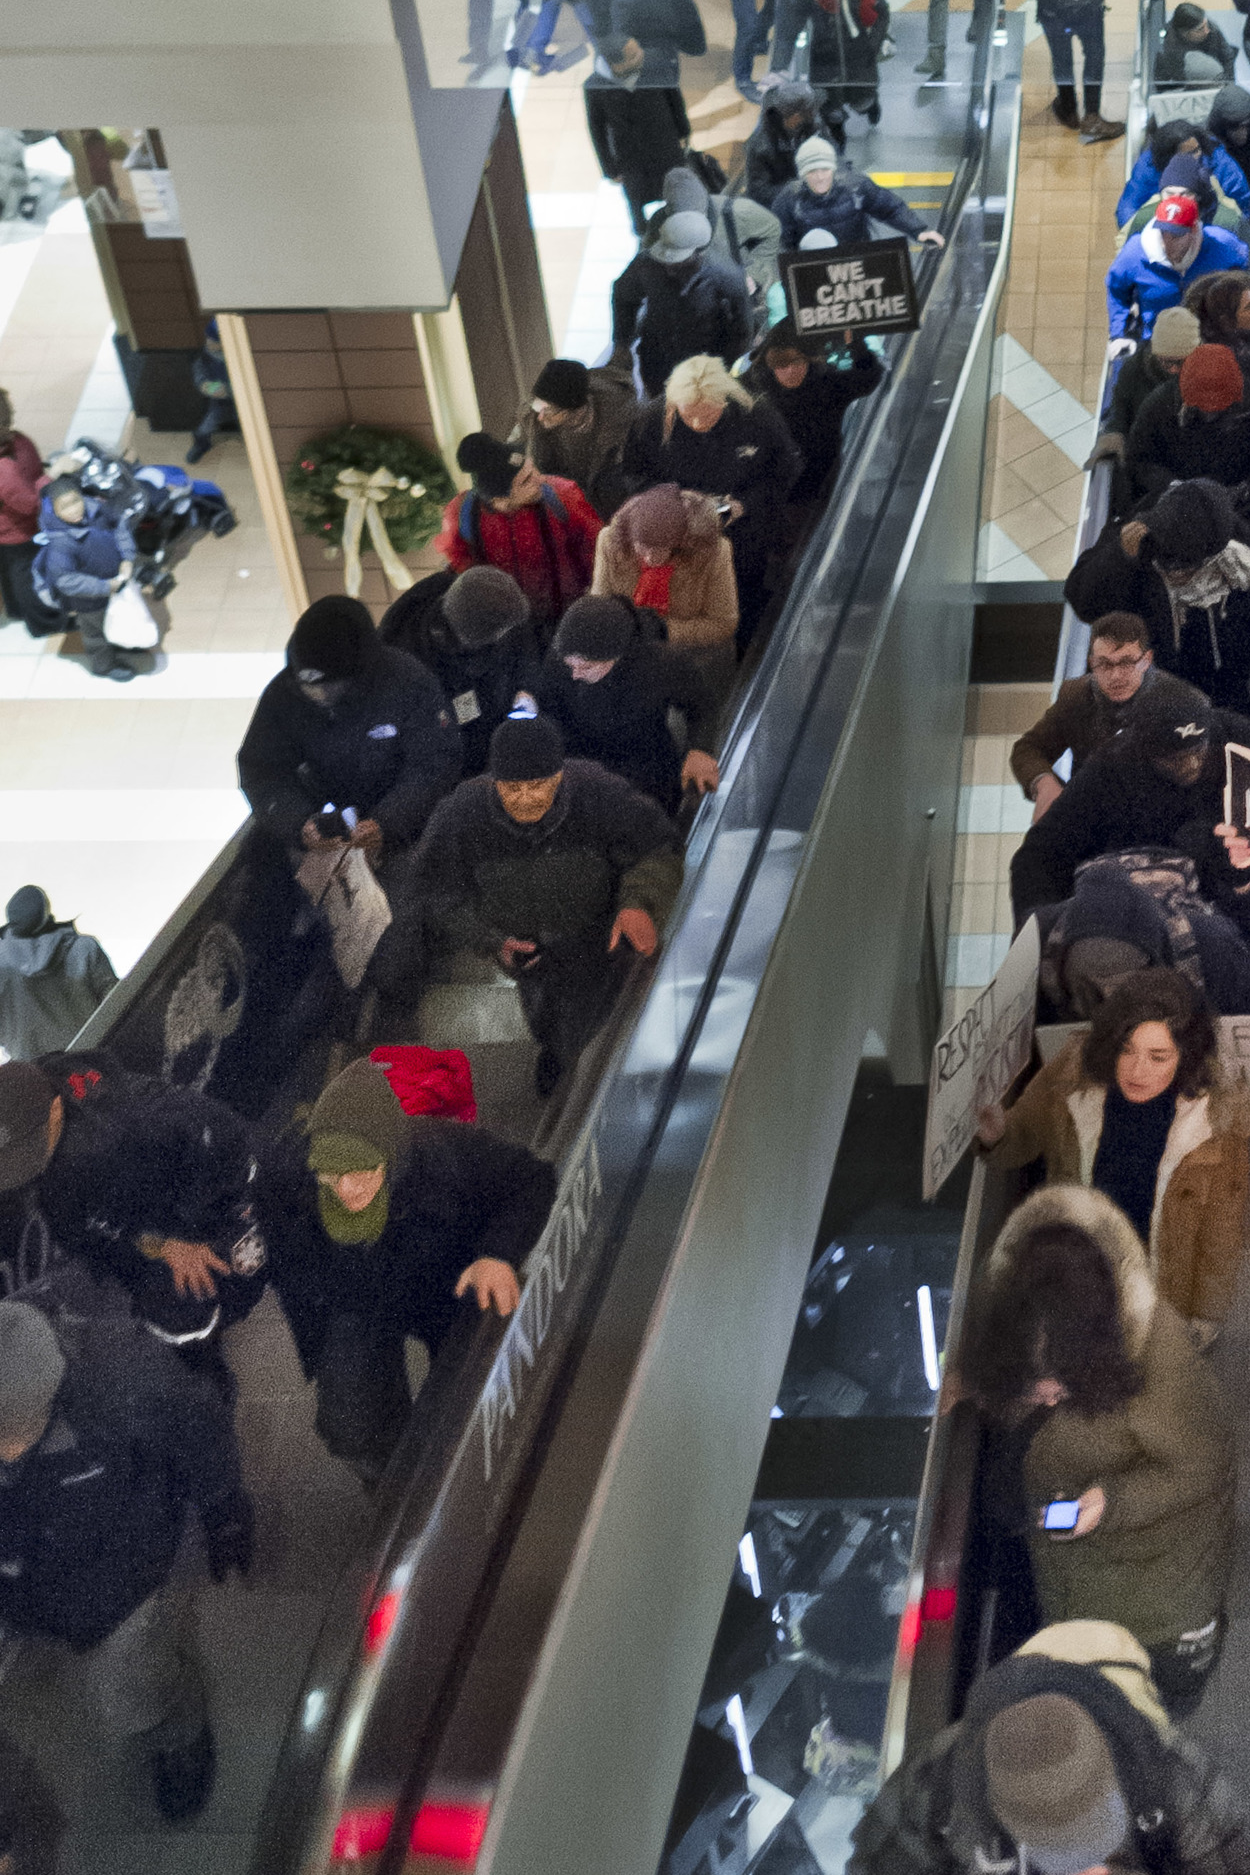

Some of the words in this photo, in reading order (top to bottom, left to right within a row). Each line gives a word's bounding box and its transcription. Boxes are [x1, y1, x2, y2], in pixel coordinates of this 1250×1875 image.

[826, 261, 865, 283] WE
[817, 278, 884, 305] CAN'T
[799, 295, 908, 328] BREATHE
